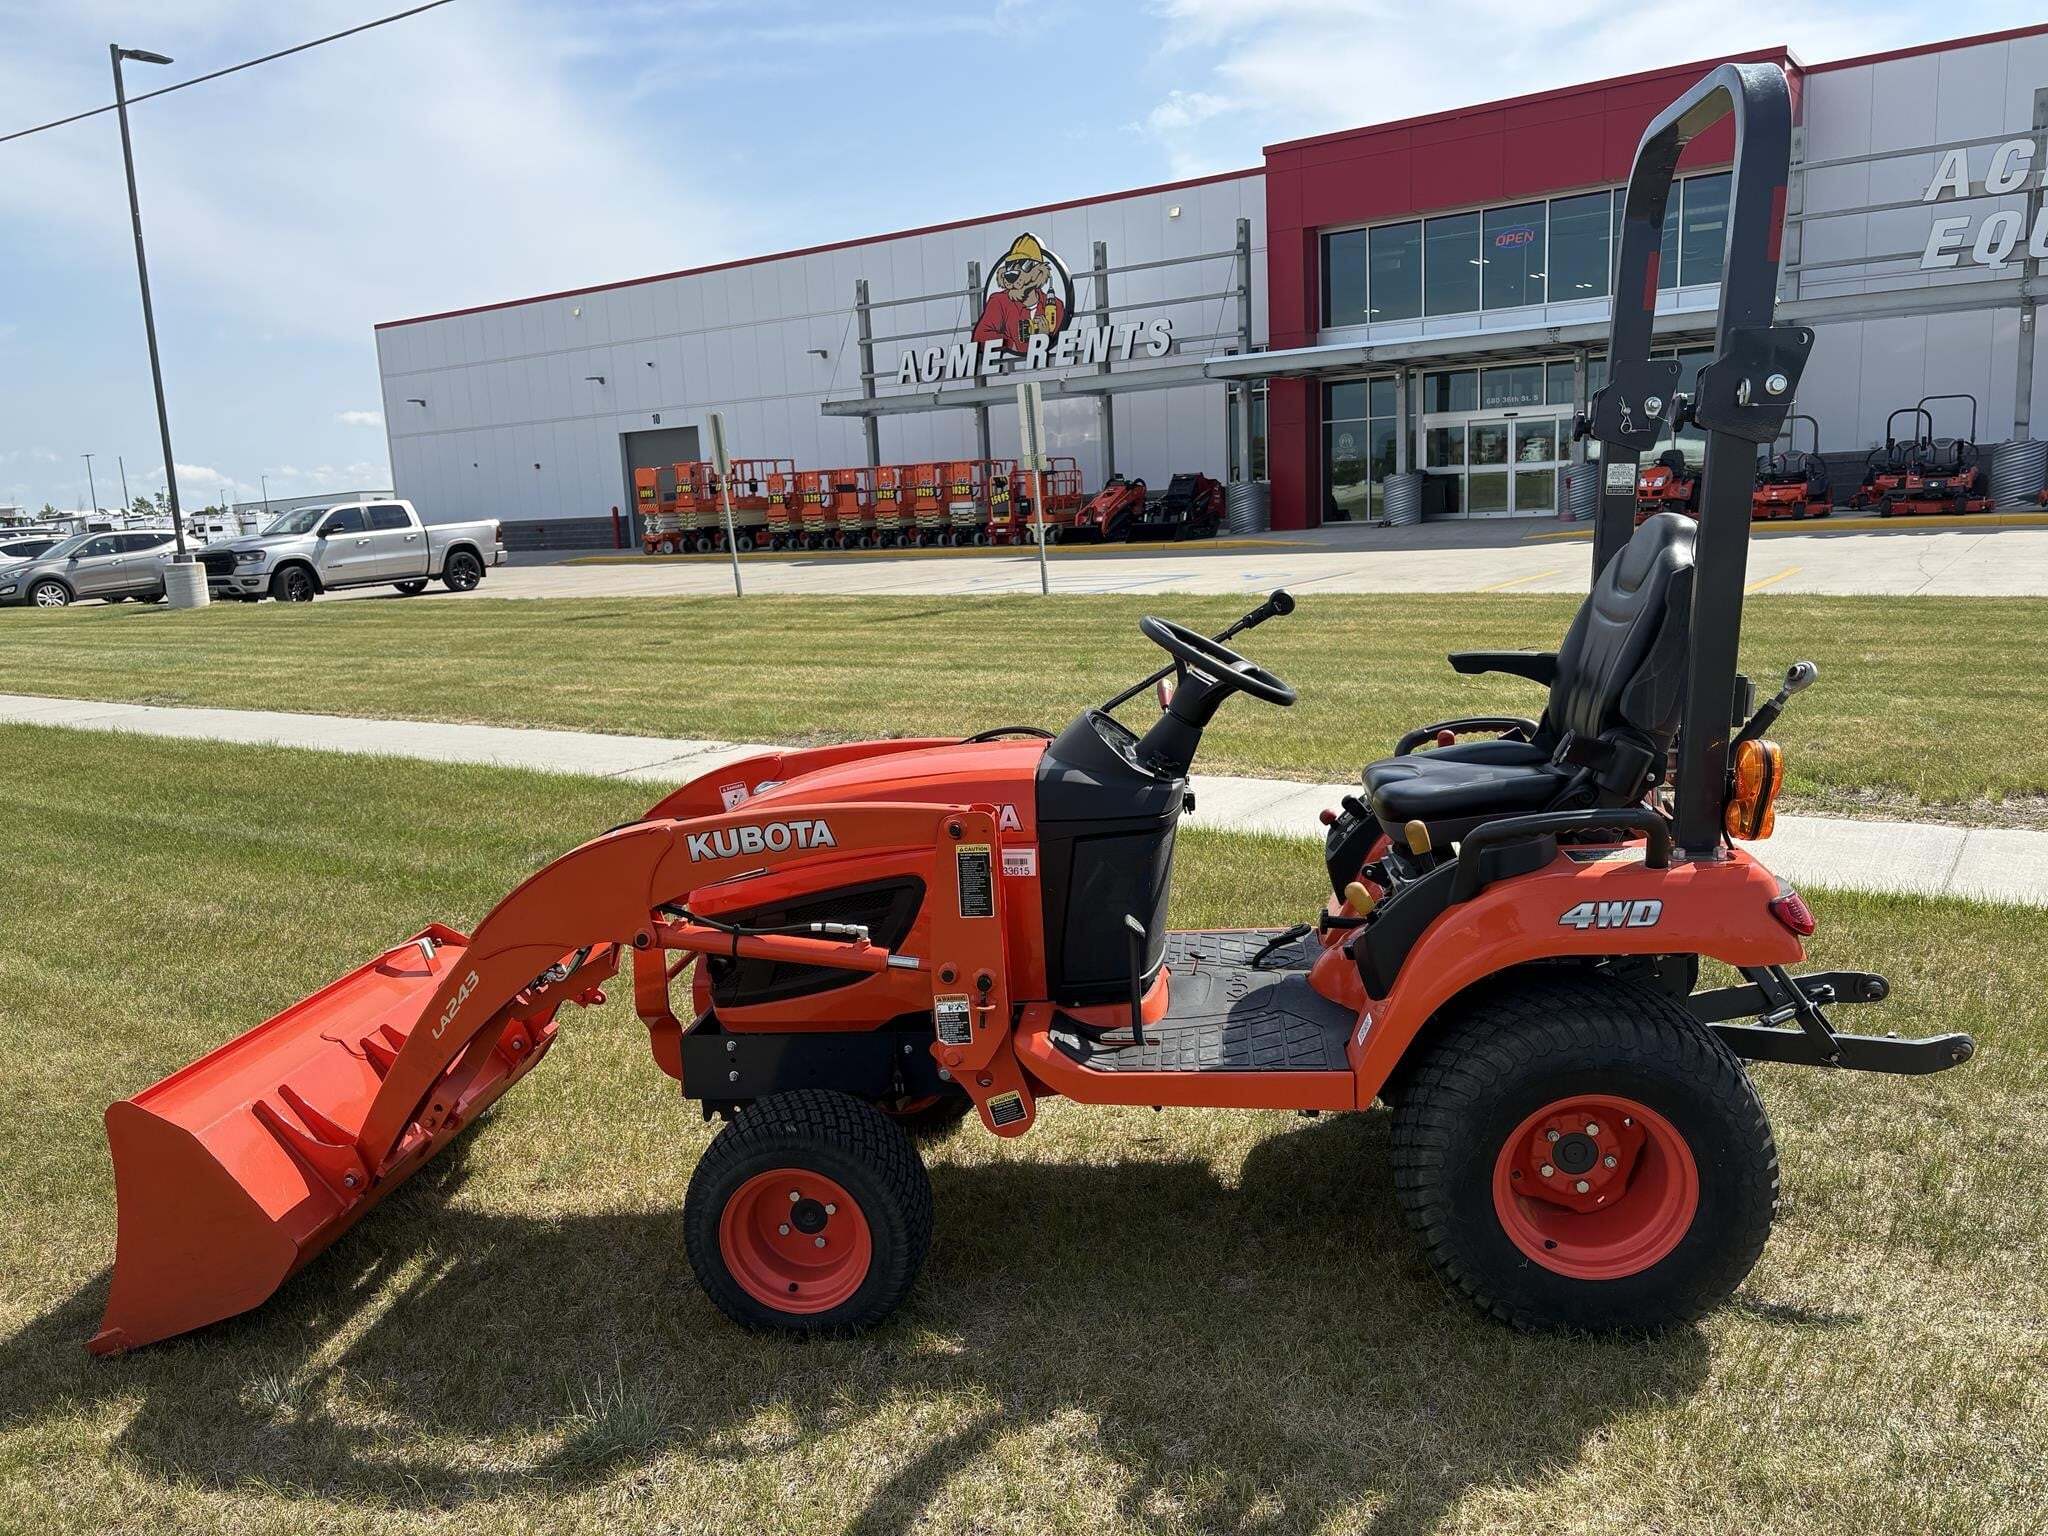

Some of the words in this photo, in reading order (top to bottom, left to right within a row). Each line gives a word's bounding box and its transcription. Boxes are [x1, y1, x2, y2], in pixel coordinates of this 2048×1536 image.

[1922, 138, 2048, 201] AC
[1496, 231, 1534, 246] OPEN
[897, 339, 1003, 385] ACME
[1026, 319, 1172, 370] RENTS
[652, 413, 661, 424] 10
[686, 820, 837, 862] KUBOTA
[1558, 899, 1663, 929] 4WD
[431, 970, 480, 1040] LA243
